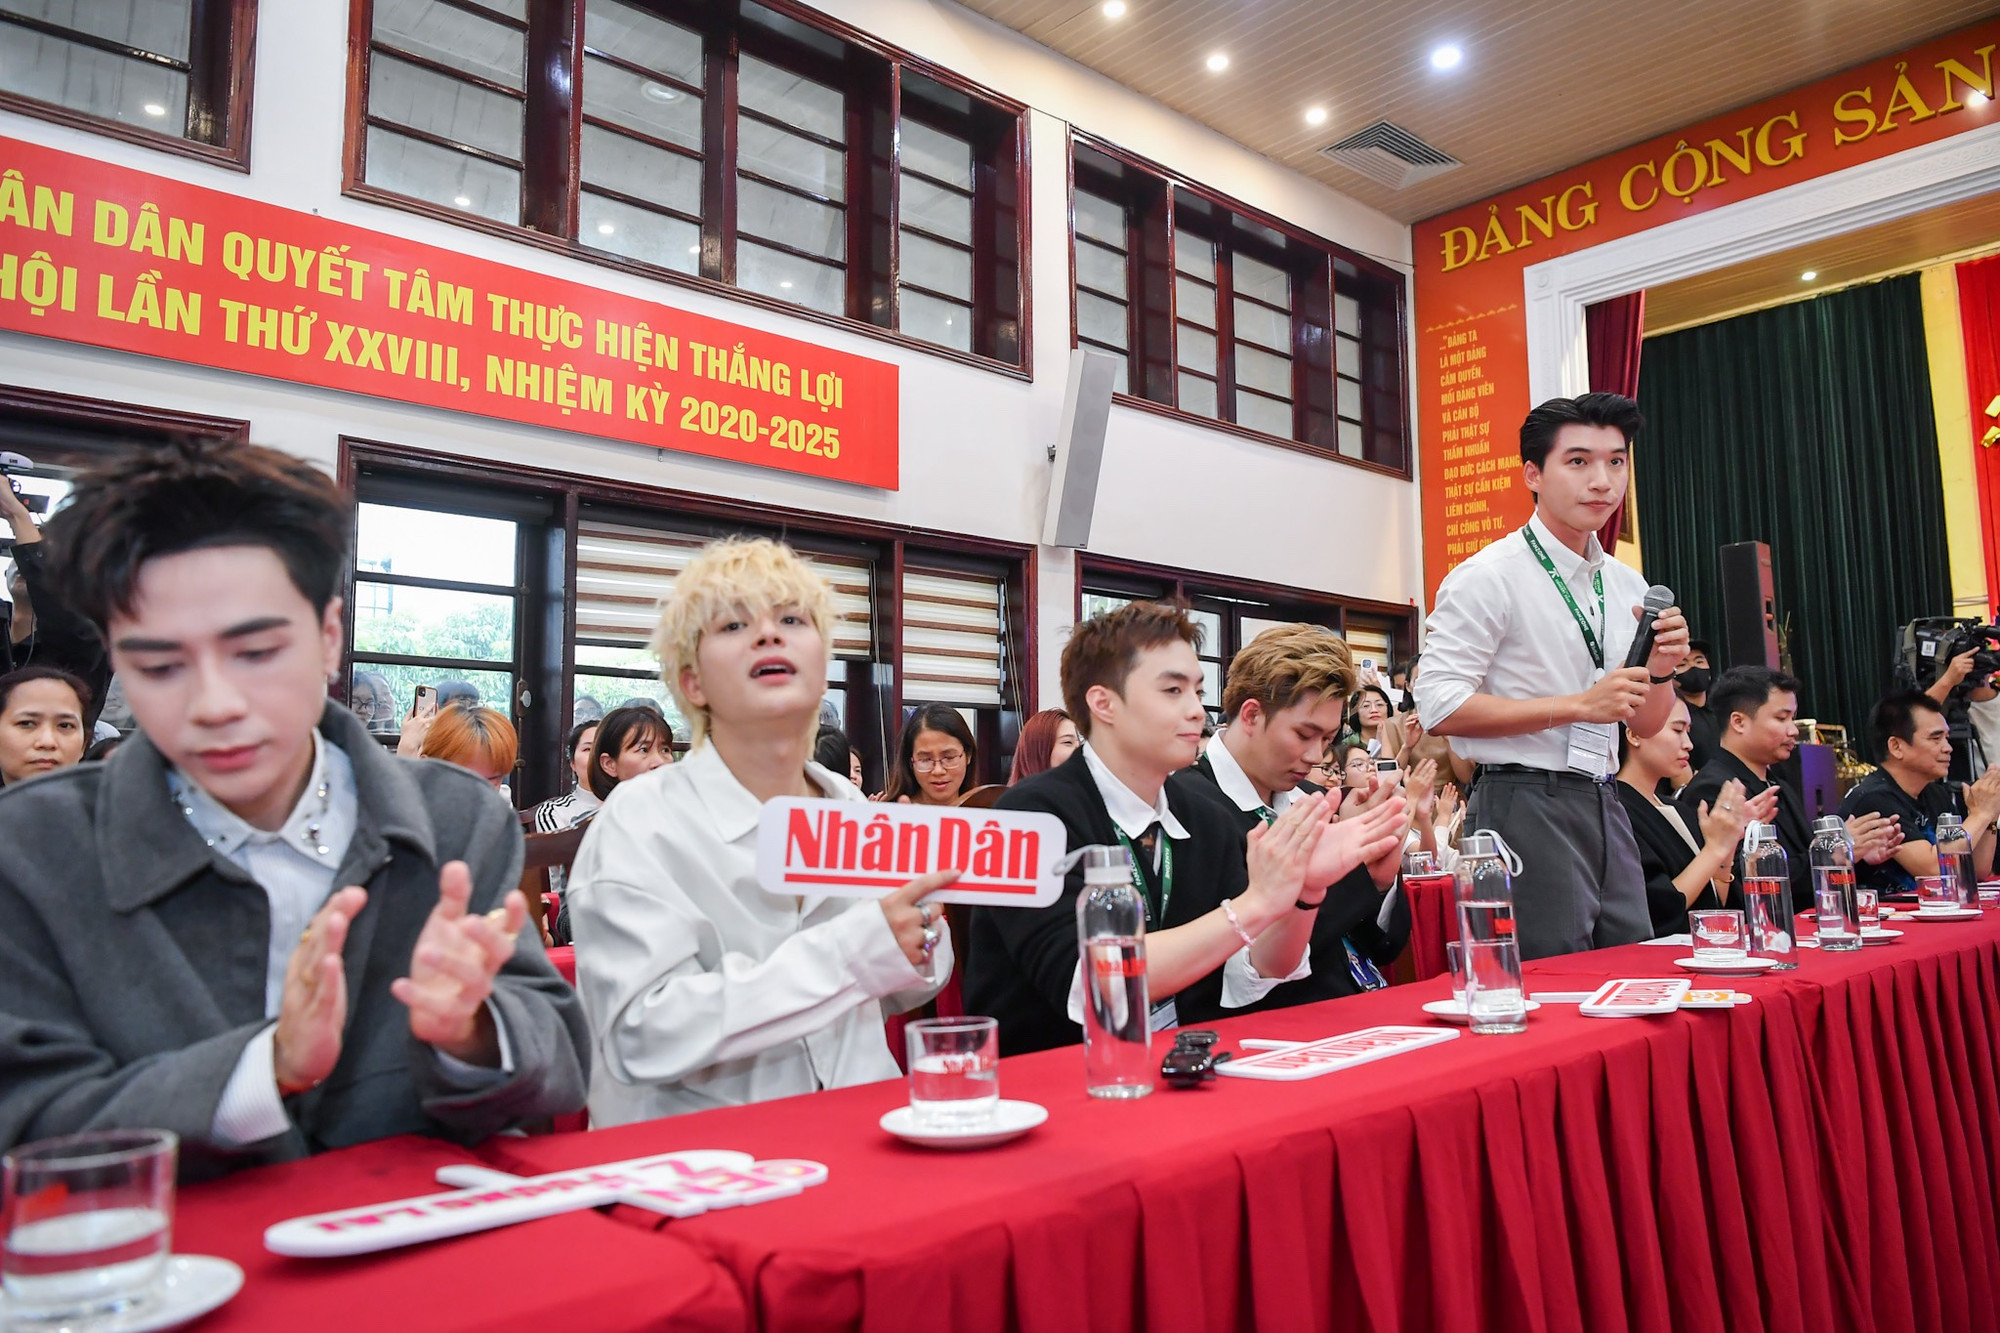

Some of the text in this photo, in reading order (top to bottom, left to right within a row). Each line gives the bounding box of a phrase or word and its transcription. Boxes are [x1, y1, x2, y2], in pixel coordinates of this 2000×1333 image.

[1440, 44, 1996, 272] ĐẢNG CỘNG SẢN
[94, 202, 205, 266] DÂN
[222, 231, 370, 302] QUYẾT
[384, 268, 474, 326] TÂM
[487, 293, 583, 352] THỰC
[596, 322, 679, 371] HIỆN
[689, 341, 791, 396] THẮNG
[800, 368, 843, 414] LỢI
[97, 268, 202, 336] LẦN
[219, 300, 316, 355] THỨ
[323, 320, 471, 392] XXVIII,
[486, 355, 613, 416] NHIỆM
[626, 382, 670, 425] KỲ
[680, 396, 840, 459] 2020-2025
[1468, 330, 1478, 342] TA
[1574, 608, 1590, 632] FANZONE
[785, 808, 1039, 880] Nhân Dân
